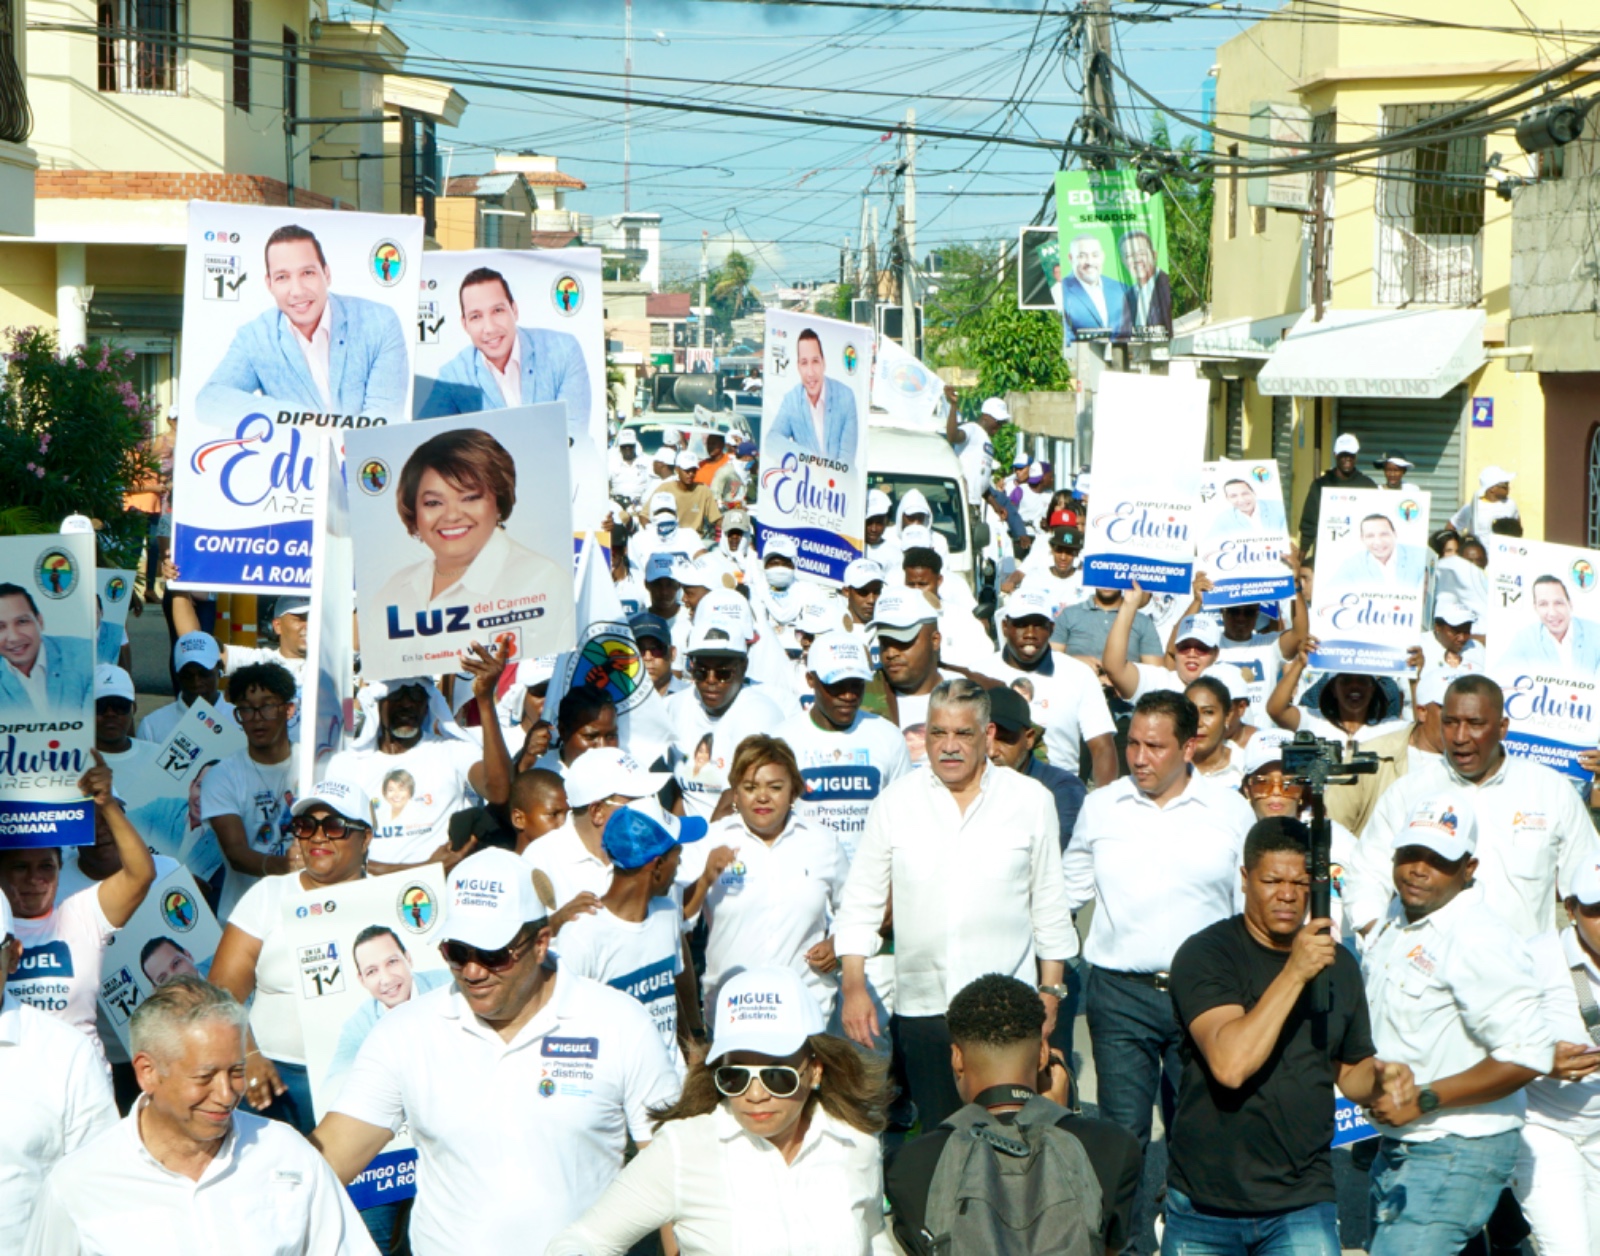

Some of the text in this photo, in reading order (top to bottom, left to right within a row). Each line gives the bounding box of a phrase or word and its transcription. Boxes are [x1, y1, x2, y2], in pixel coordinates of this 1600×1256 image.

[1079, 213, 1137, 222] SENADOR
[228, 256, 235, 268] 4
[207, 267, 235, 275] VOTA
[213, 274, 224, 298] 1
[1261, 376, 1340, 394] COLMADO
[1345, 378, 1361, 395] EL
[1364, 379, 1431, 395] MOLINO
[276, 410, 388, 429] DIPUTADO
[798, 452, 849, 473] DIPUTADO
[773, 452, 849, 518] Edwin
[1135, 500, 1192, 511] DIPUTADO
[1106, 501, 1190, 544] Edwin
[194, 535, 280, 555] CONTIGO
[801, 538, 853, 563] GANAREMOS
[241, 565, 264, 581] LA
[1090, 560, 1186, 577] CONTIGO GANAREMOS
[1114, 571, 1167, 584] LA ROMANA
[1242, 579, 1289, 591] GANAREMOS
[1514, 574, 1522, 587] 4
[1229, 586, 1275, 599] LA ROMANA
[1501, 591, 1508, 608] 1
[473, 600, 494, 614] del
[496, 593, 547, 611] Carmen
[482, 608, 540, 628] DIPUTADA
[1331, 593, 1414, 632] Edwin
[402, 653, 414, 662] En
[415, 652, 423, 661] la
[424, 650, 455, 661] Casilla
[455, 648, 463, 657] 4
[1534, 674, 1596, 691] DIPUTADO
[1504, 675, 1592, 723] Edwin
[163, 755, 177, 770] 1
[717, 757, 724, 769] 3
[1527, 753, 1569, 768] ROMANA
[806, 776, 872, 793] MIGUEL
[424, 793, 433, 805] 3
[0, 809, 85, 823] GANAREMOS
[455, 879, 505, 894] MIGUEL
[461, 898, 498, 909] distinto
[301, 942, 338, 965] CASILLA 4
[120, 968, 133, 984] 4
[304, 965, 329, 975] VOTA
[312, 973, 323, 996] 1
[109, 990, 129, 1005] VOTA
[727, 992, 783, 1008] MIGUEL
[117, 999, 131, 1018] 1
[737, 1012, 778, 1021] distinto
[546, 1042, 593, 1053] MIGUEL
[553, 1060, 594, 1069] Presidente
[551, 1068, 594, 1080] distinto
[1337, 1121, 1354, 1132] LA
[376, 1178, 394, 1192] LA
